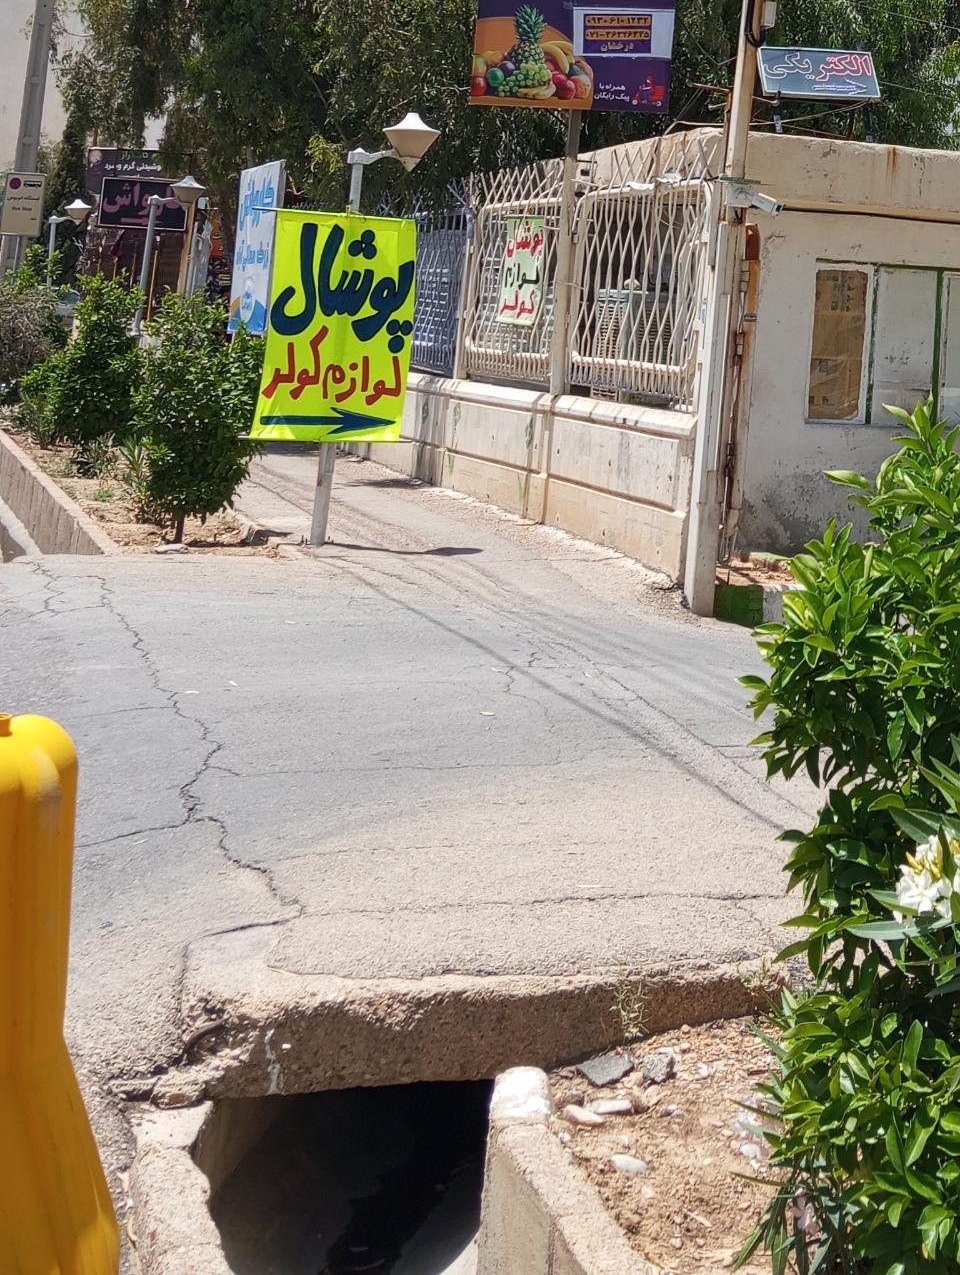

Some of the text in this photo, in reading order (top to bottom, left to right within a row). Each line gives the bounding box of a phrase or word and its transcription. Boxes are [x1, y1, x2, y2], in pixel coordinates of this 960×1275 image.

[764, 52, 872, 82] الکتریکی
[605, 84, 626, 92] همراه
[136, 162, 162, 172] وشیدنی
[270, 222, 415, 354] پوشال
[262, 324, 402, 406] لوازم کولر
